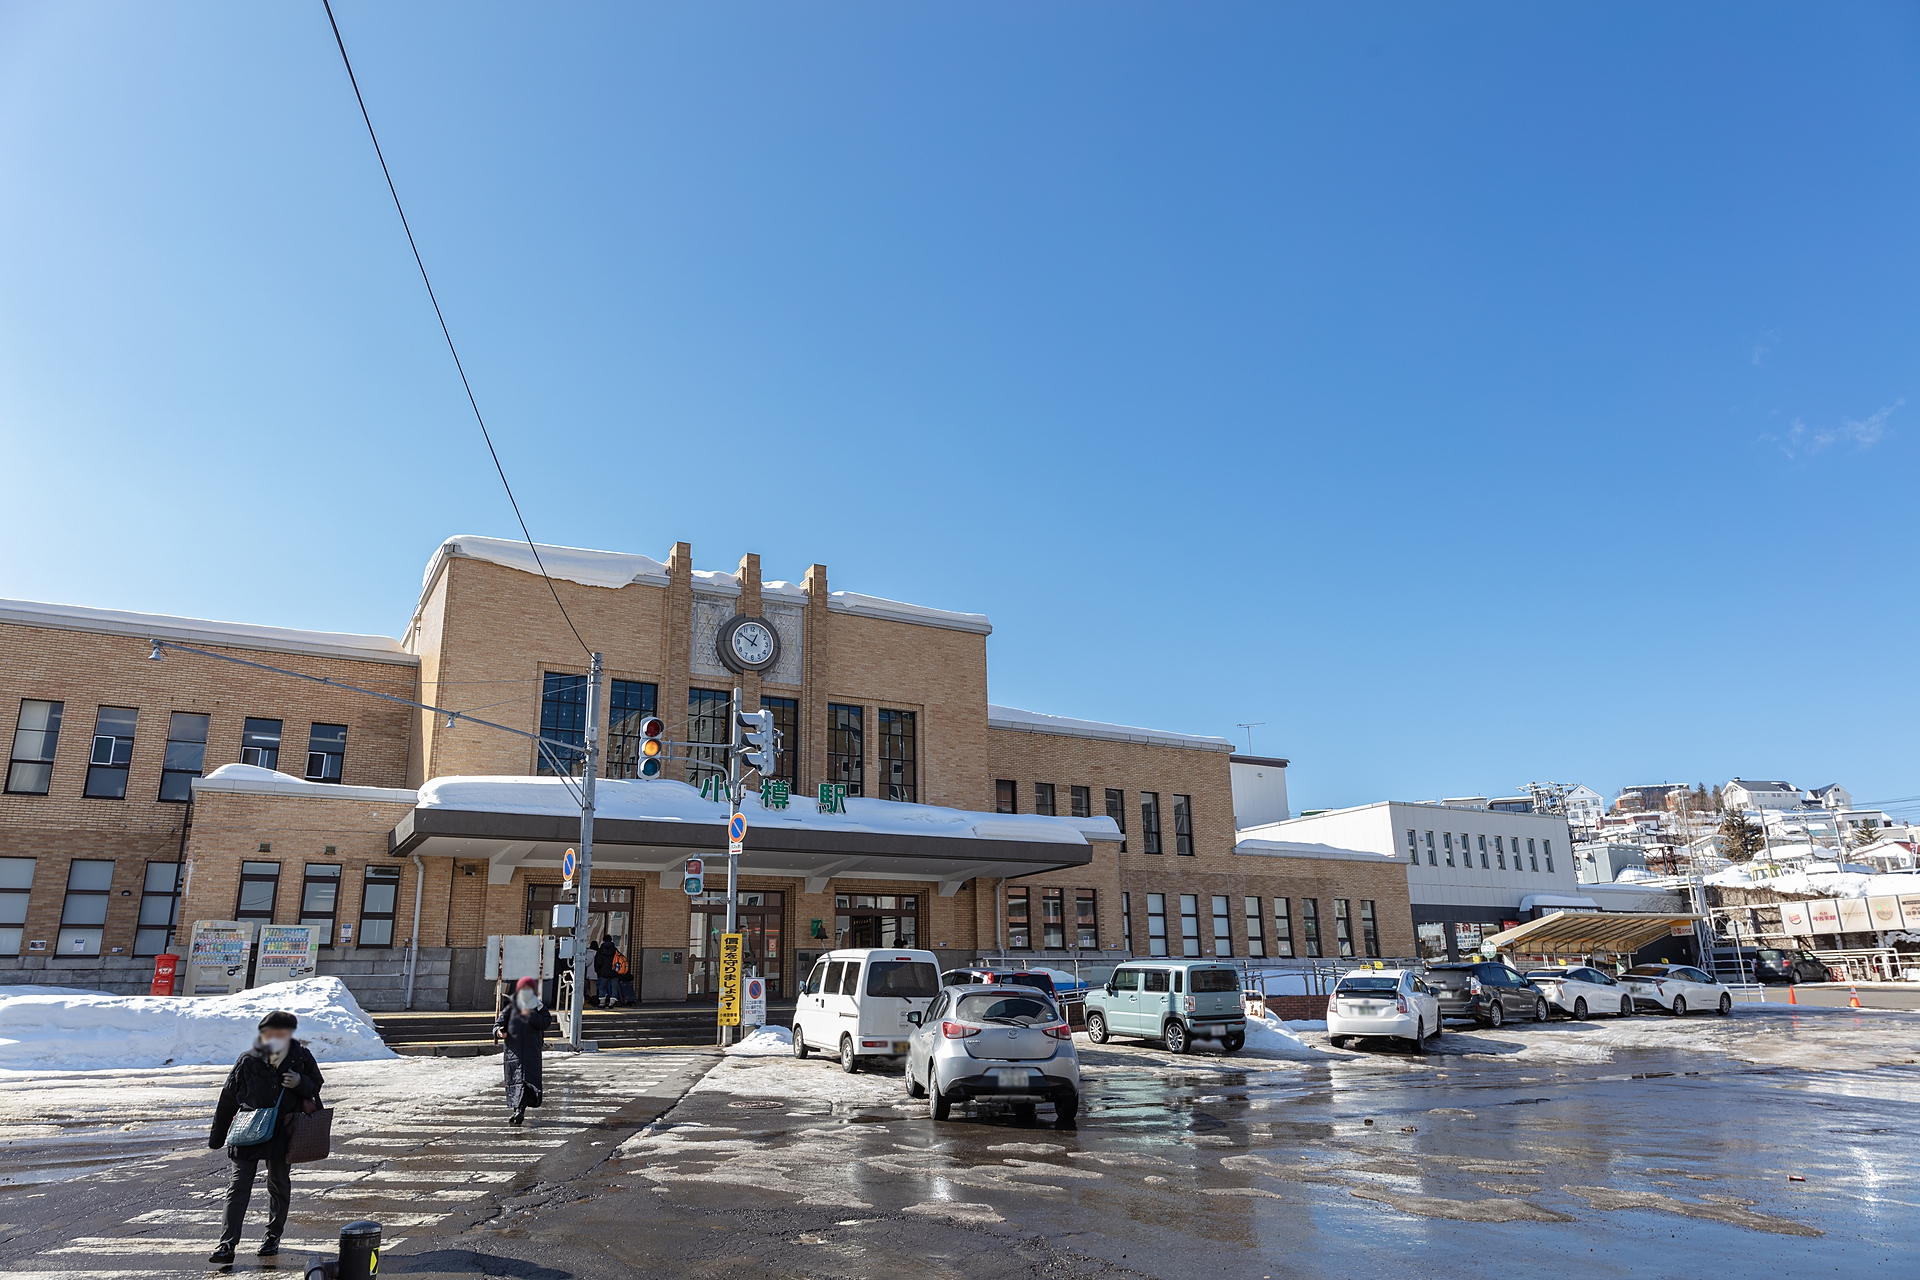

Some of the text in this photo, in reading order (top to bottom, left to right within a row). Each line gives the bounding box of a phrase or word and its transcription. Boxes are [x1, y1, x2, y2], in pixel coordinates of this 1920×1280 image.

[700, 774, 847, 815] 小樽駅
[720, 937, 739, 1010] 信号を守りましょう!
